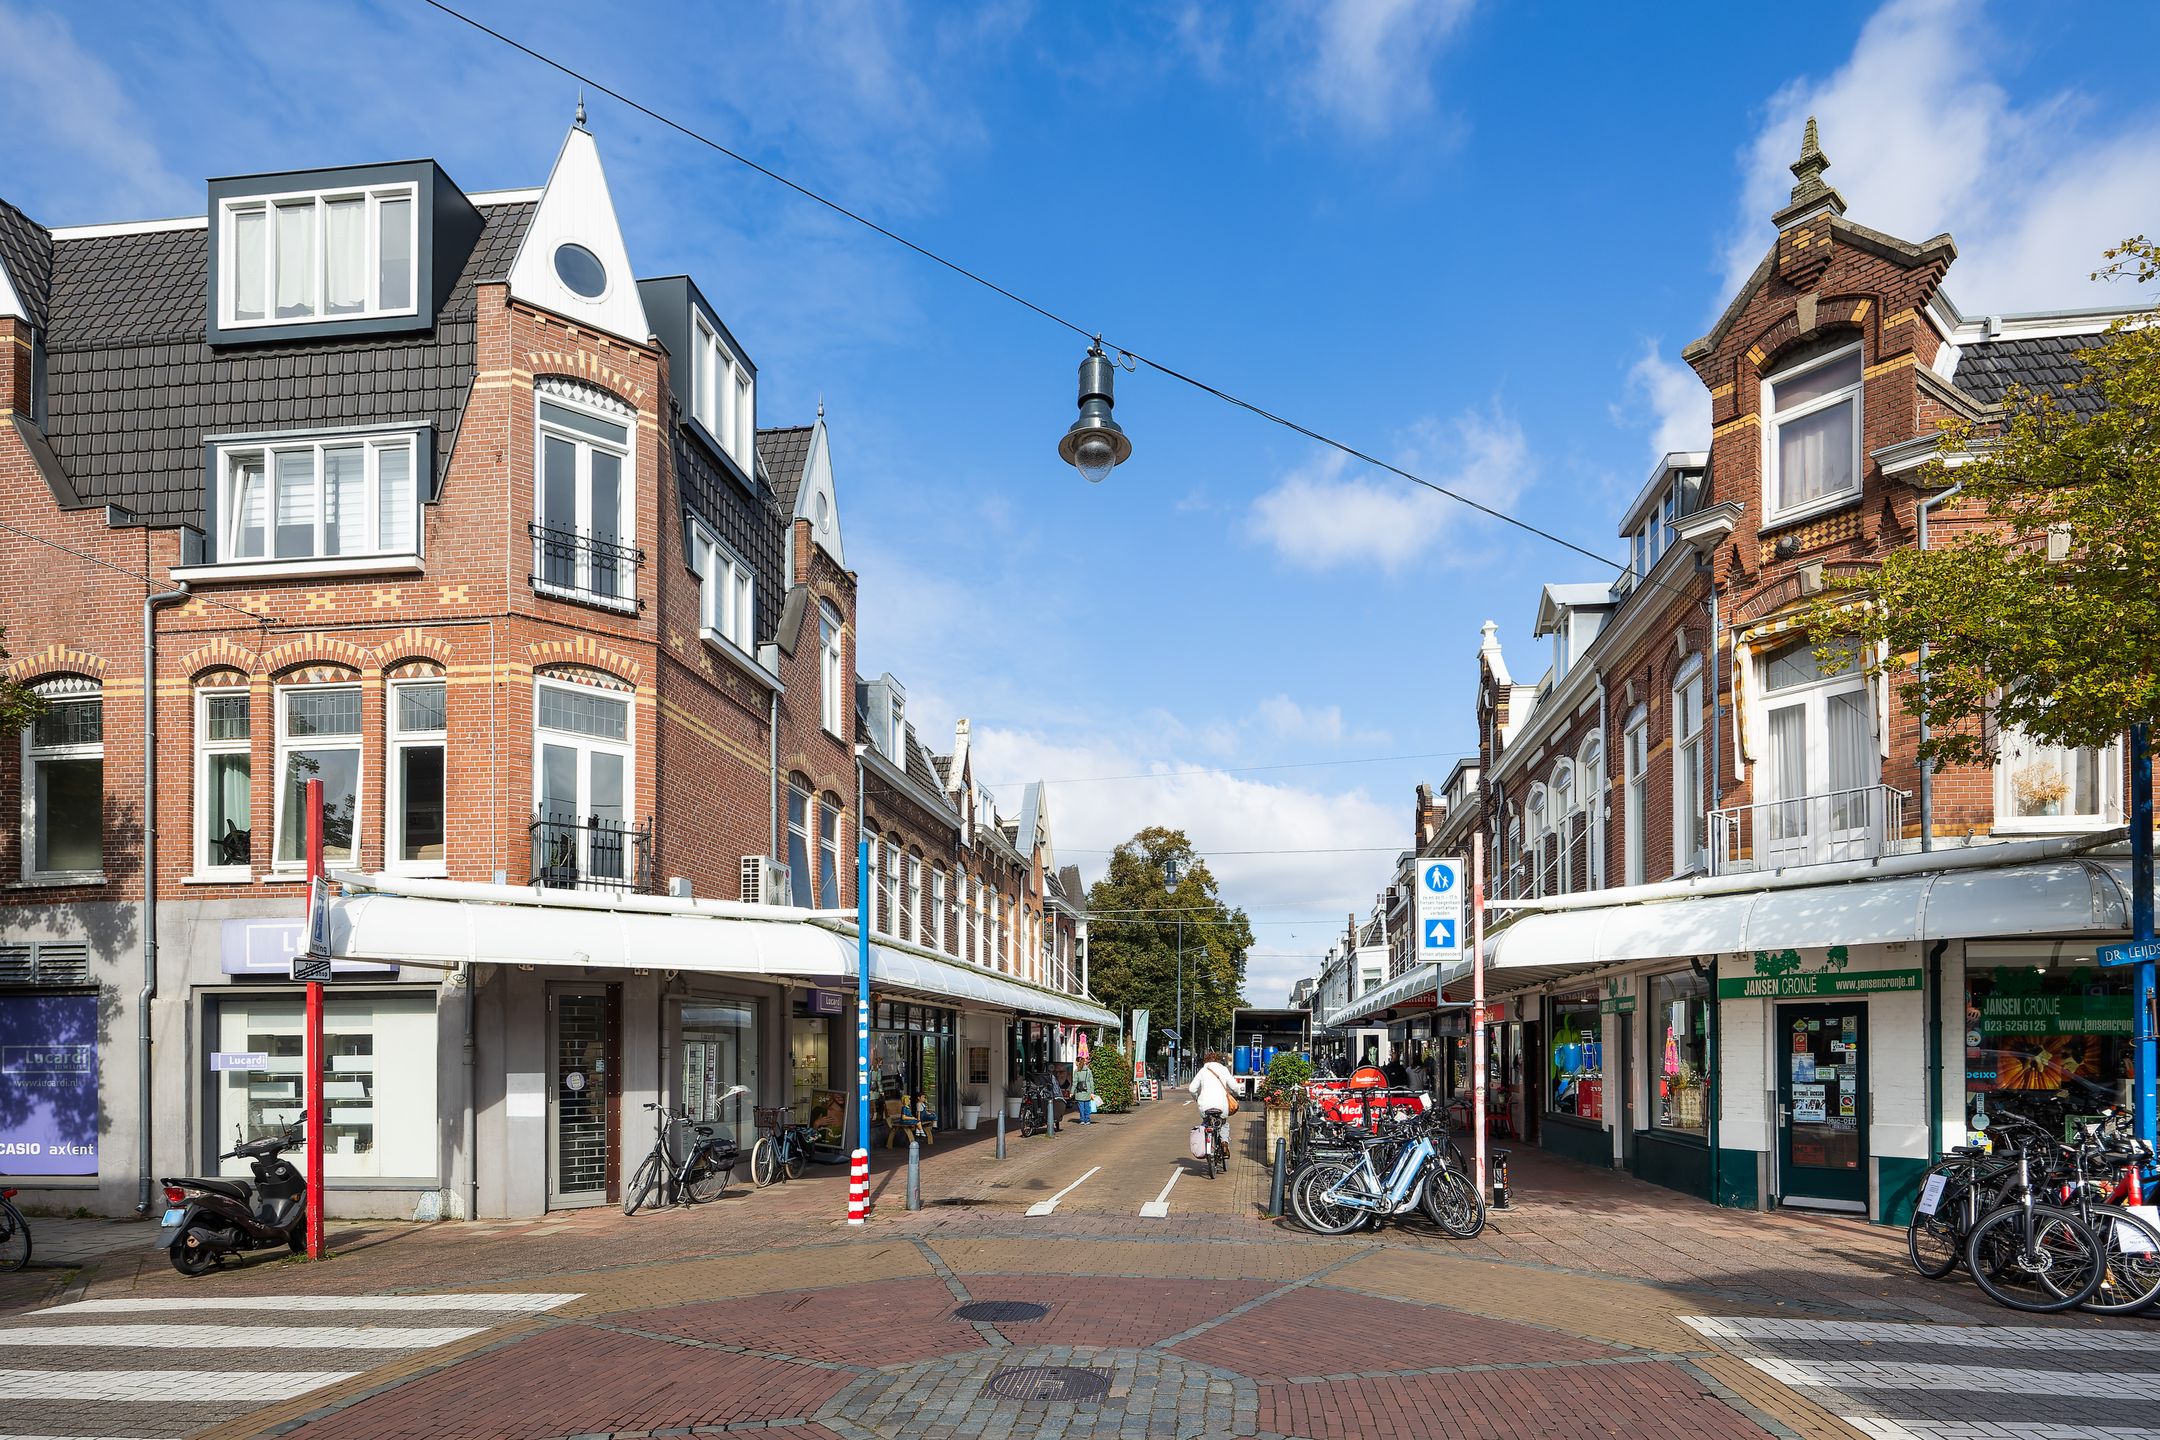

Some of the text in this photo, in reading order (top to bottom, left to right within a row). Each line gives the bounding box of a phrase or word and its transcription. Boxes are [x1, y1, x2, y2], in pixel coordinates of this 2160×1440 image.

[2105, 949, 2125, 962] DR.
[1744, 975, 1916, 996] JANSEN CRONJÉ www.jansencronje.nl
[1984, 997, 2060, 1016] JANSEN CRONJÉ
[1984, 1020, 2047, 1032] 023-5256125
[26, 1049, 87, 1064] Lucardi
[230, 1056, 265, 1065] Lucardi
[15, 1079, 78, 1087] www.lucardi.nl
[0, 1143, 41, 1155] CASIO
